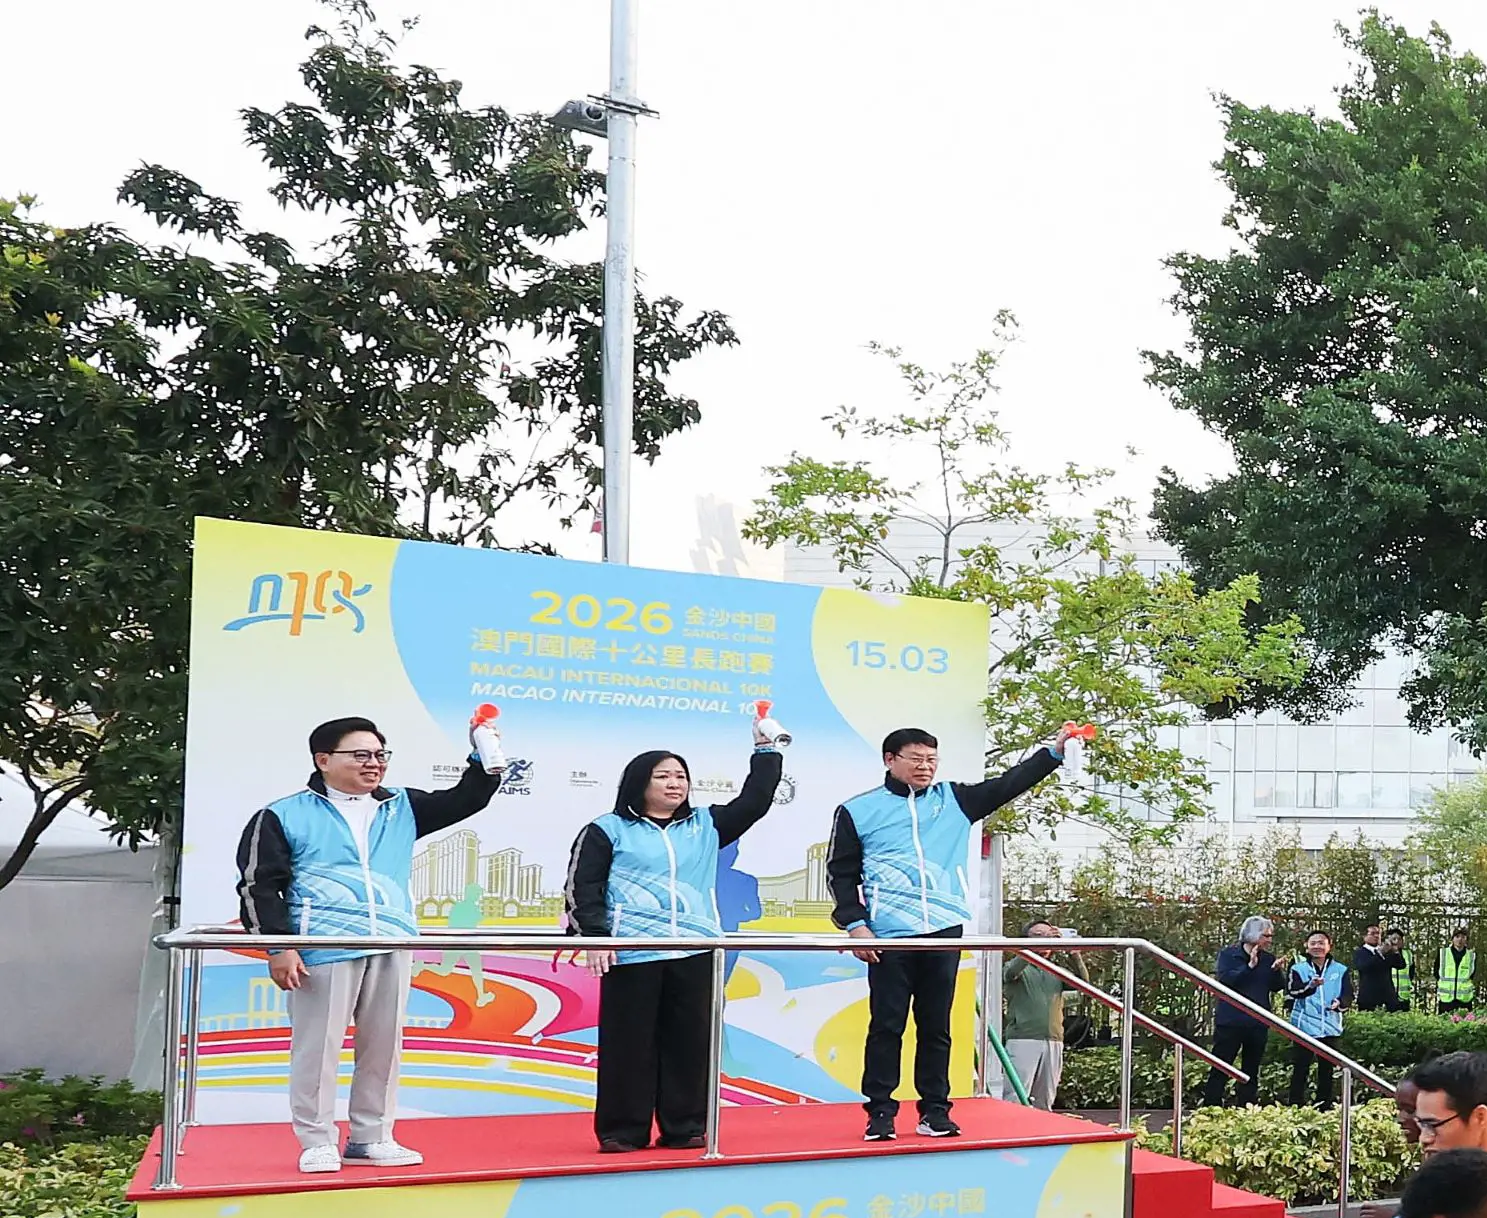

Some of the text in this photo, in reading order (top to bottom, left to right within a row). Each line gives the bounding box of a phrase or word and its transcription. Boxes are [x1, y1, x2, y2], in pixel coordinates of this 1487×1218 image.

[529, 590, 674, 635] 2026
[685, 605, 777, 633] 金沙中國
[470, 627, 774, 676] 澳門國際十公里長跑賽
[683, 628, 775, 645] SANDS CHINA
[845, 640, 949, 675] 15.03
[469, 661, 772, 697] MACAU INTERNACIONAL 10K
[470, 681, 557, 702] MACAO
[562, 688, 732, 714] INTERNATIONAL
[498, 786, 531, 796] AIMS
